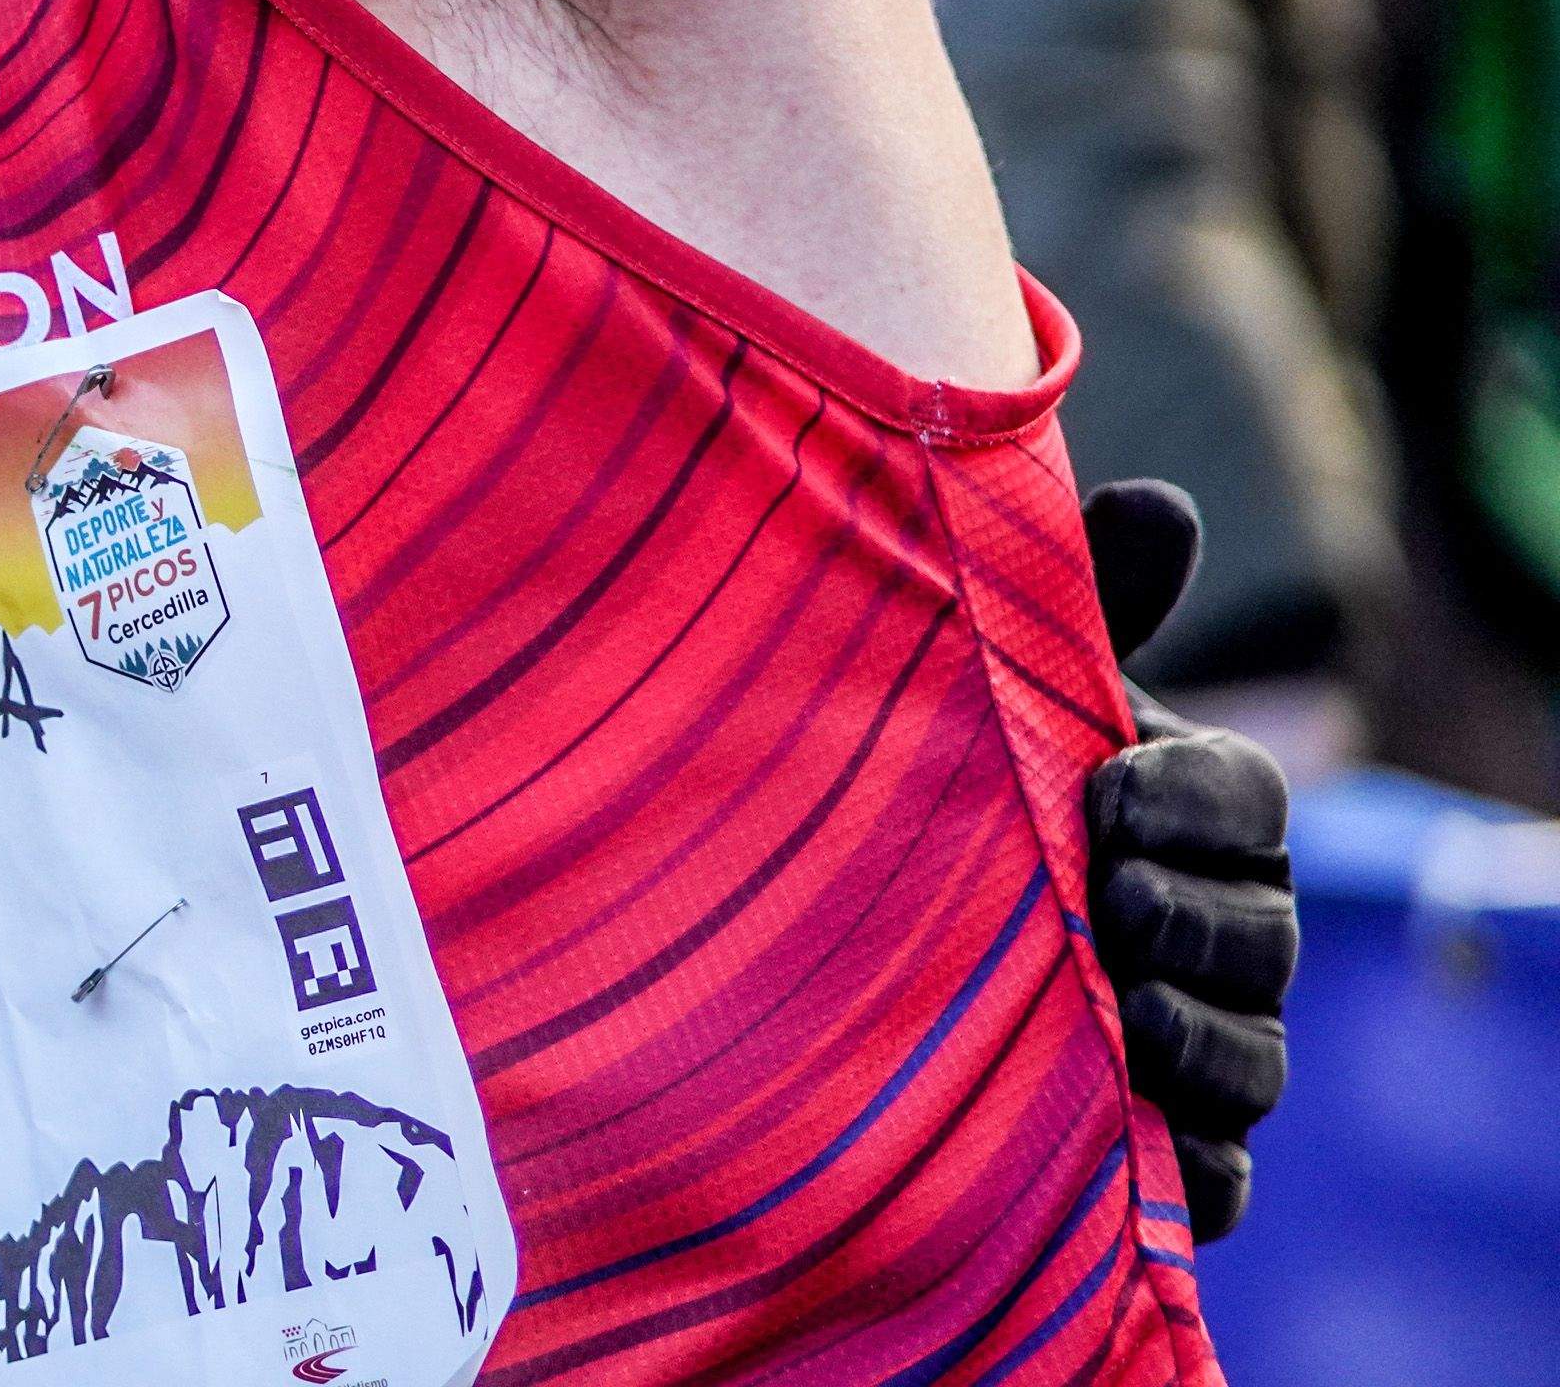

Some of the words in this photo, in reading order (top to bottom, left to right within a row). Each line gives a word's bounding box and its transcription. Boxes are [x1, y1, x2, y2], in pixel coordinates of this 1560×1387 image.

[64, 494, 150, 556] DEPORTE
[65, 515, 188, 592] NATURALEZA
[77, 589, 102, 640] 7
[106, 548, 198, 612] PICOS
[107, 588, 209, 645] Cercedilla
[301, 1006, 386, 1040] getpica.com
